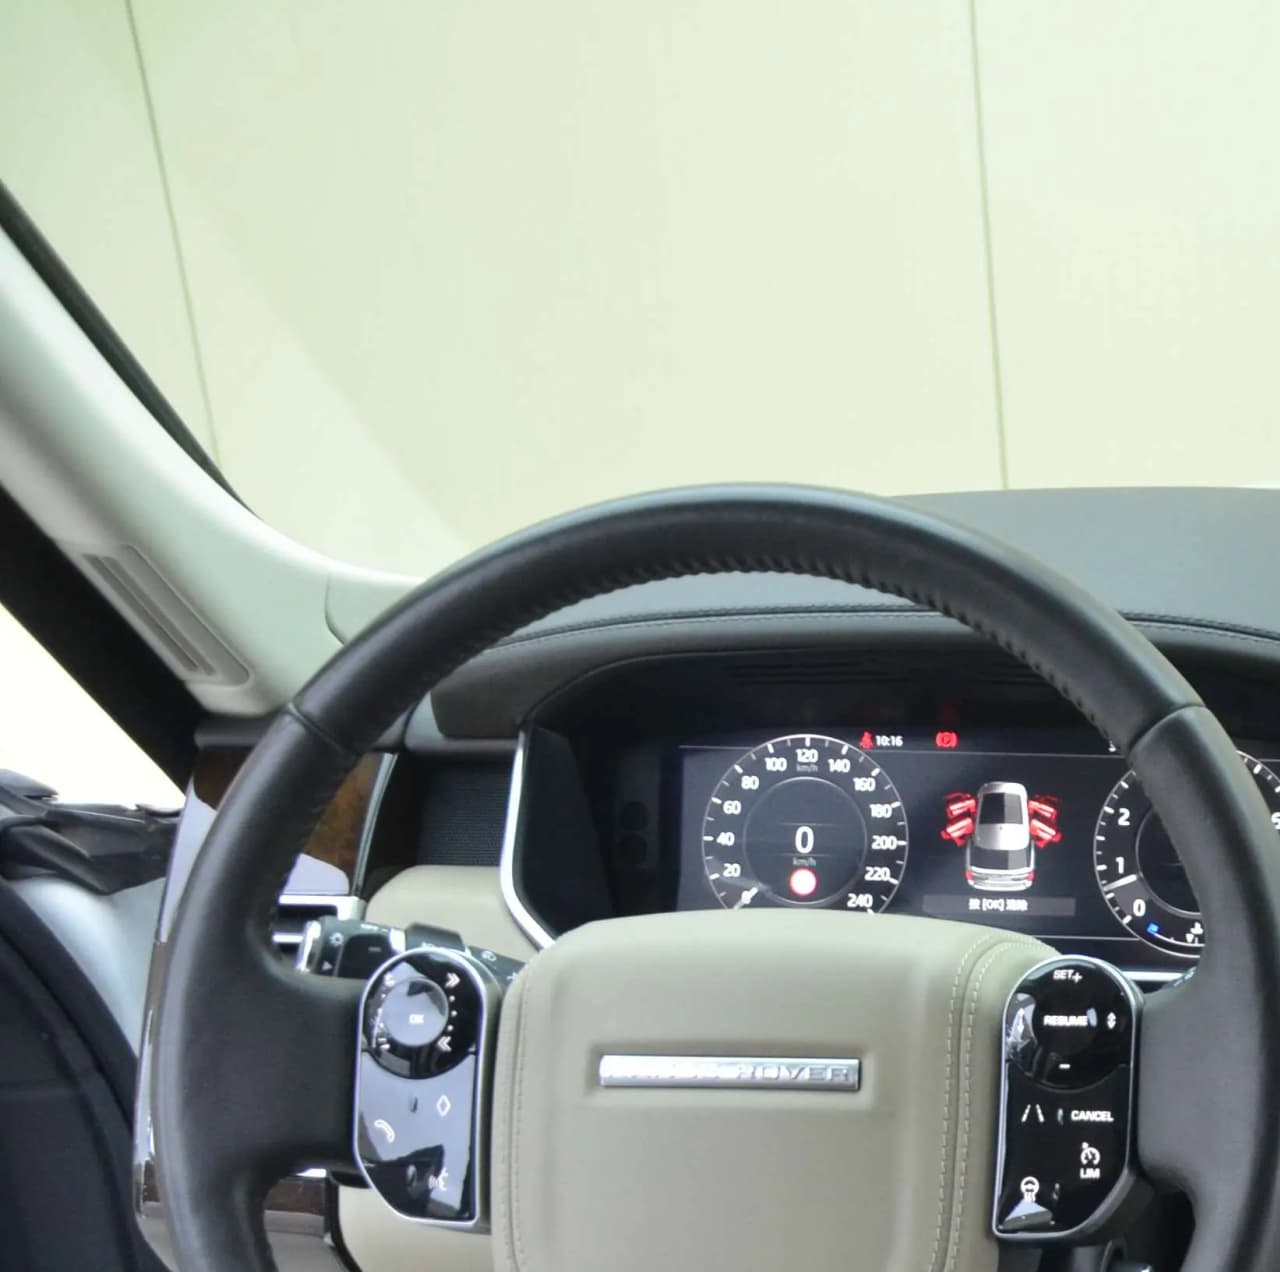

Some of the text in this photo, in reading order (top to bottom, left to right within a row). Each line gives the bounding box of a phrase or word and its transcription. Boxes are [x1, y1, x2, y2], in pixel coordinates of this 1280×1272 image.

[875, 735, 904, 747] 10:16
[795, 749, 819, 763] 120
[764, 757, 788, 772] 100
[828, 758, 851, 773] 140
[741, 775, 760, 790] 80
[853, 777, 876, 792] 160
[723, 800, 742, 815] 60
[869, 804, 893, 819] 180
[1117, 807, 1130, 826] 2
[716, 832, 735, 846] 40
[795, 826, 815, 854] 0
[872, 835, 897, 850] 200
[723, 863, 741, 877] 20
[1115, 857, 1125, 874] 1
[864, 867, 891, 881] 220
[847, 893, 873, 907] 240
[1132, 899, 1146, 917] 0
[1043, 1015, 1088, 1027] RESUME
[1070, 1110, 1114, 1122] CANCEL
[1080, 1168, 1100, 1179] LIM
